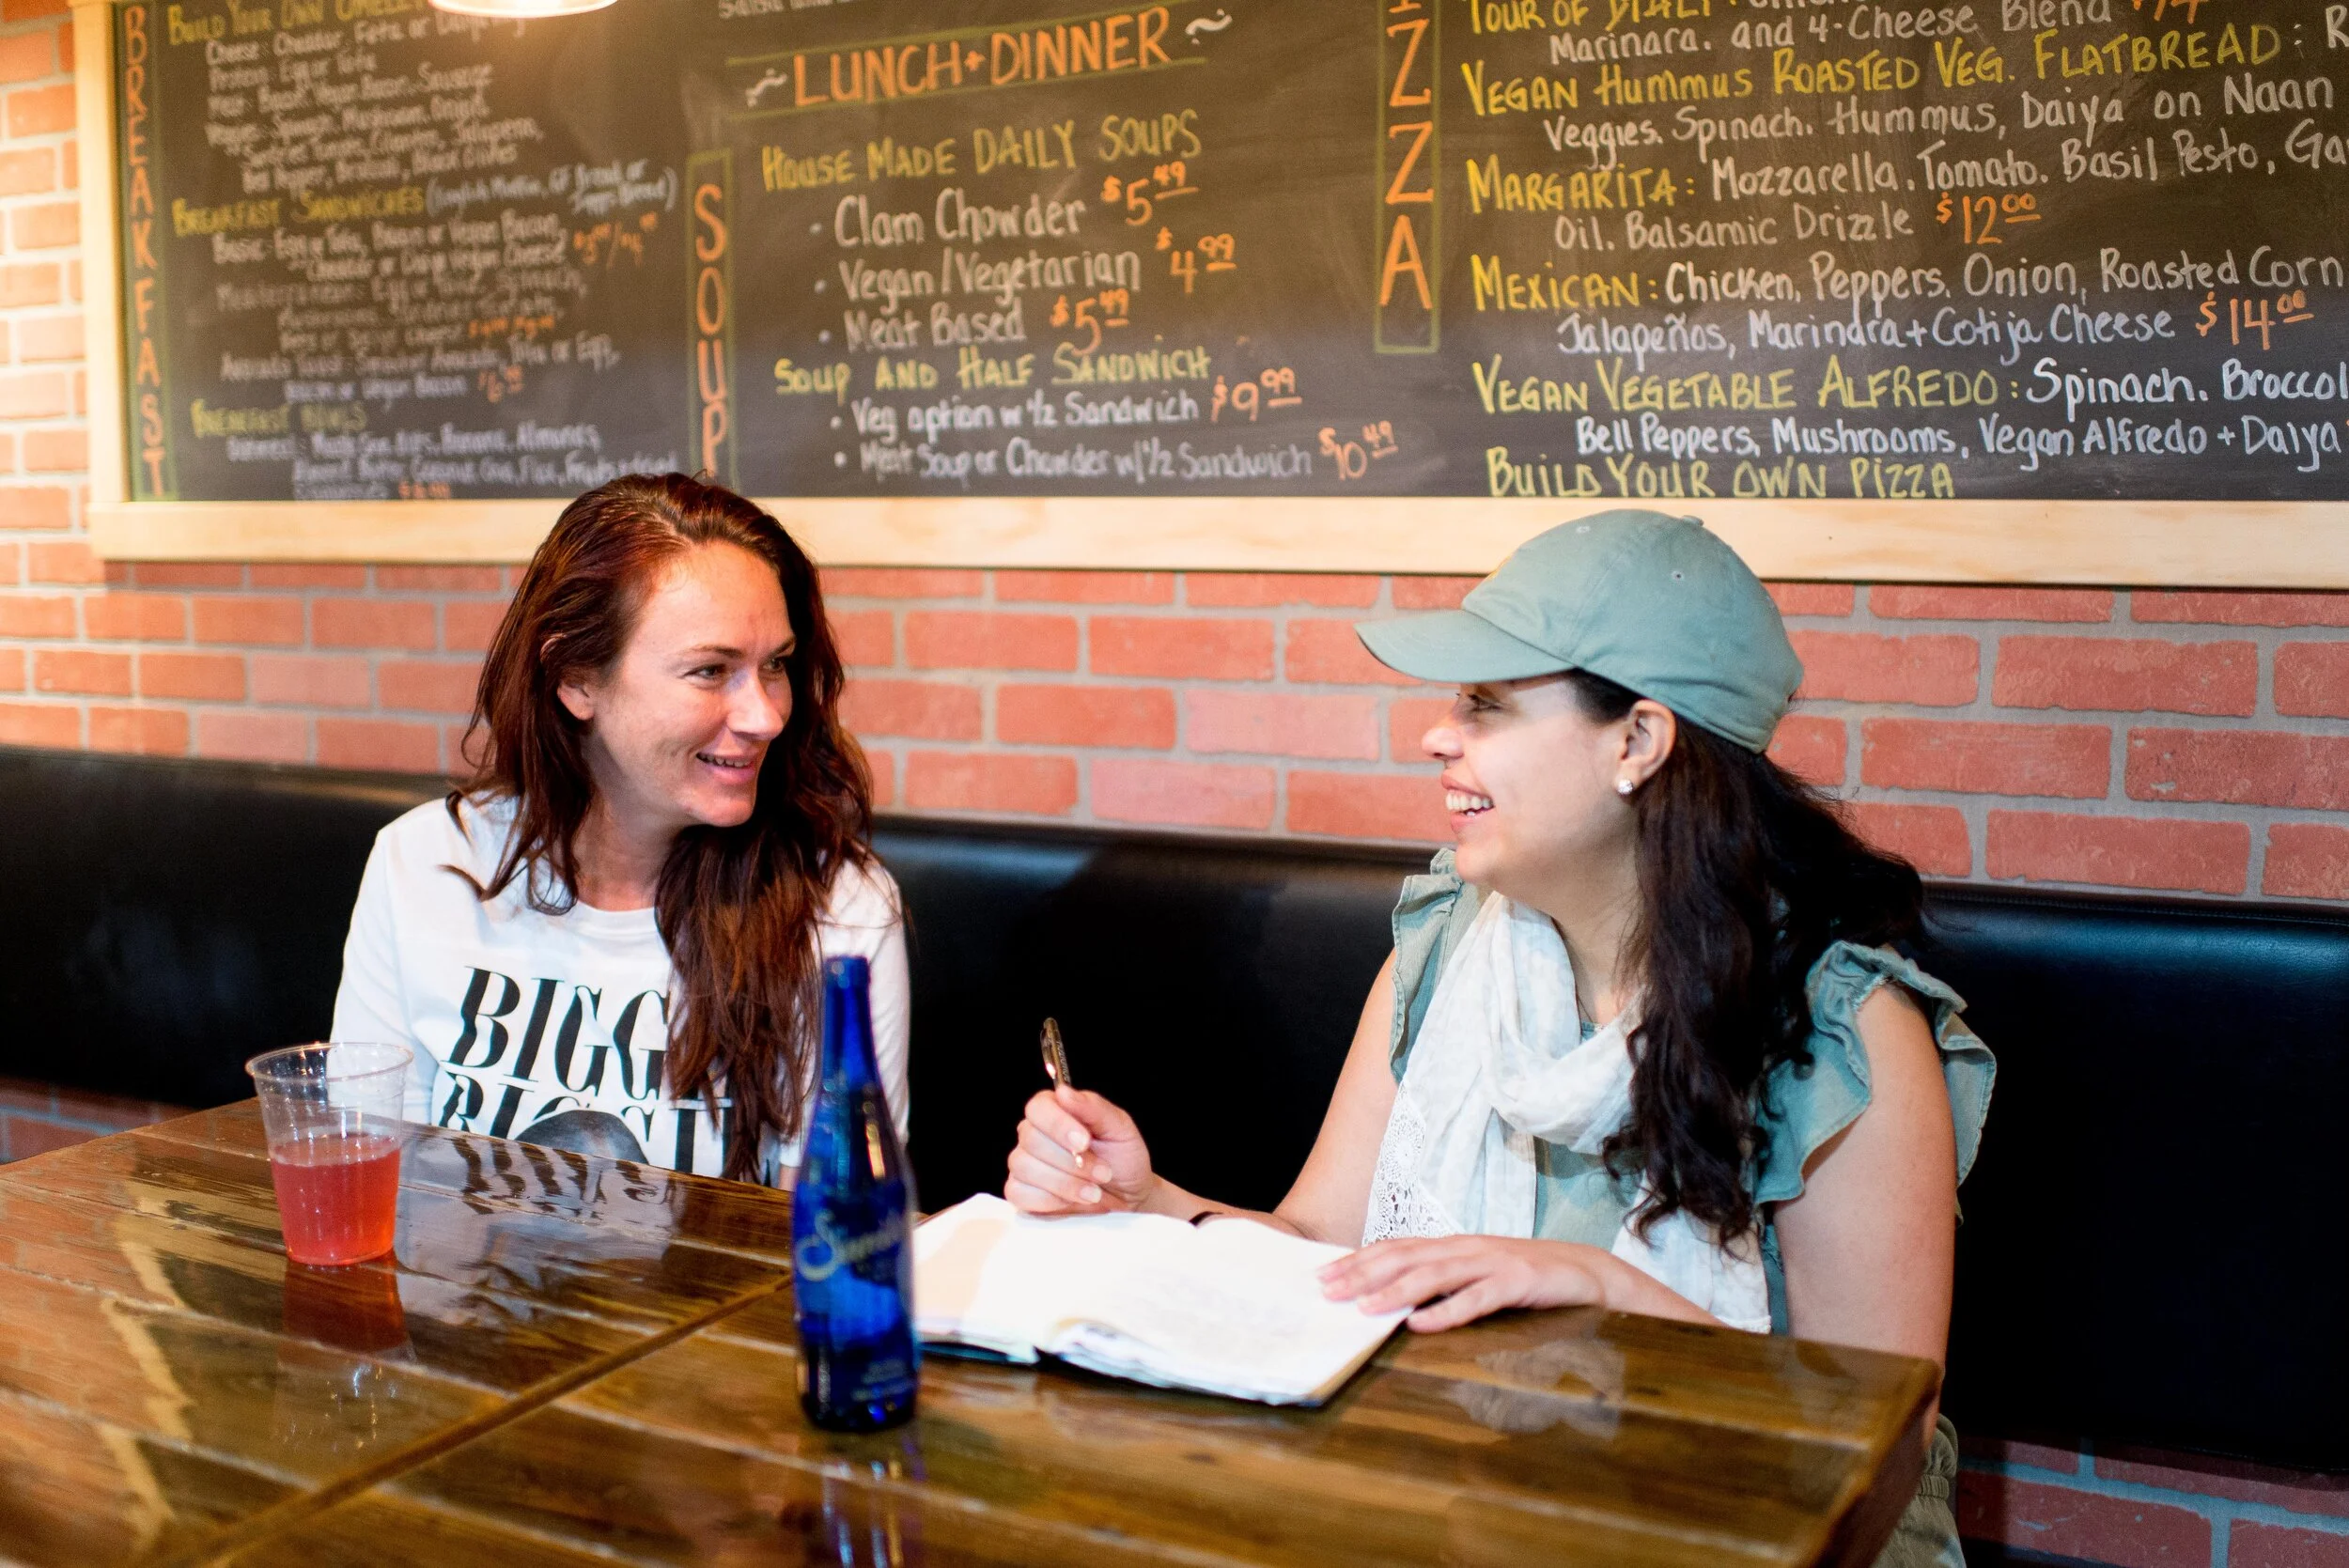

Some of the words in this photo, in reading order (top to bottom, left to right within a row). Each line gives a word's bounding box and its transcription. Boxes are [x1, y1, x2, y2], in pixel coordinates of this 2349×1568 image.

[1731, 15, 1795, 50] and
[1461, 59, 1579, 116] VEGAN
[1773, 47, 1921, 94] ROASTED
[1827, 94, 2007, 140] Hummus,
[2021, 85, 2124, 147] Daiya
[2154, 90, 2201, 120] on
[2224, 71, 2334, 115] Naan
[762, 146, 856, 193] HOUSE
[866, 137, 957, 181] MADE
[973, 119, 1077, 175] DAILY
[1098, 108, 1202, 163] SOUPS
[2061, 137, 2158, 183] Basil
[834, 194, 925, 247] Clam
[935, 187, 1086, 244] Chowder
[1626, 210, 1779, 250] Balsamic
[1793, 200, 1915, 241] Drizzle
[2100, 247, 2241, 293] Roasted
[2249, 245, 2344, 287] Corn
[844, 309, 922, 353] Meat
[930, 297, 1027, 347] Based
[2050, 303, 2176, 344] Cheese
[875, 356, 939, 391] AND
[956, 345, 1035, 391] HALF
[1051, 335, 1211, 386] SANDWICH
[1471, 353, 1589, 414] VEGAN
[1595, 356, 1797, 411] VEGETABLE
[850, 396, 898, 445] Veg
[908, 395, 996, 445] option
[1065, 388, 1199, 427] Sandwich
[1575, 415, 1633, 457] Bell
[1640, 411, 1761, 460] Peppers,
[1978, 411, 2075, 472] Vegan
[2082, 416, 2208, 456] Alfredo
[1175, 442, 1313, 481] Sandwich
[1486, 445, 1602, 498] BUILD
[1606, 452, 1716, 498] YOUR
[1733, 455, 1826, 498] OWN
[1850, 457, 1955, 498] PIZZA
